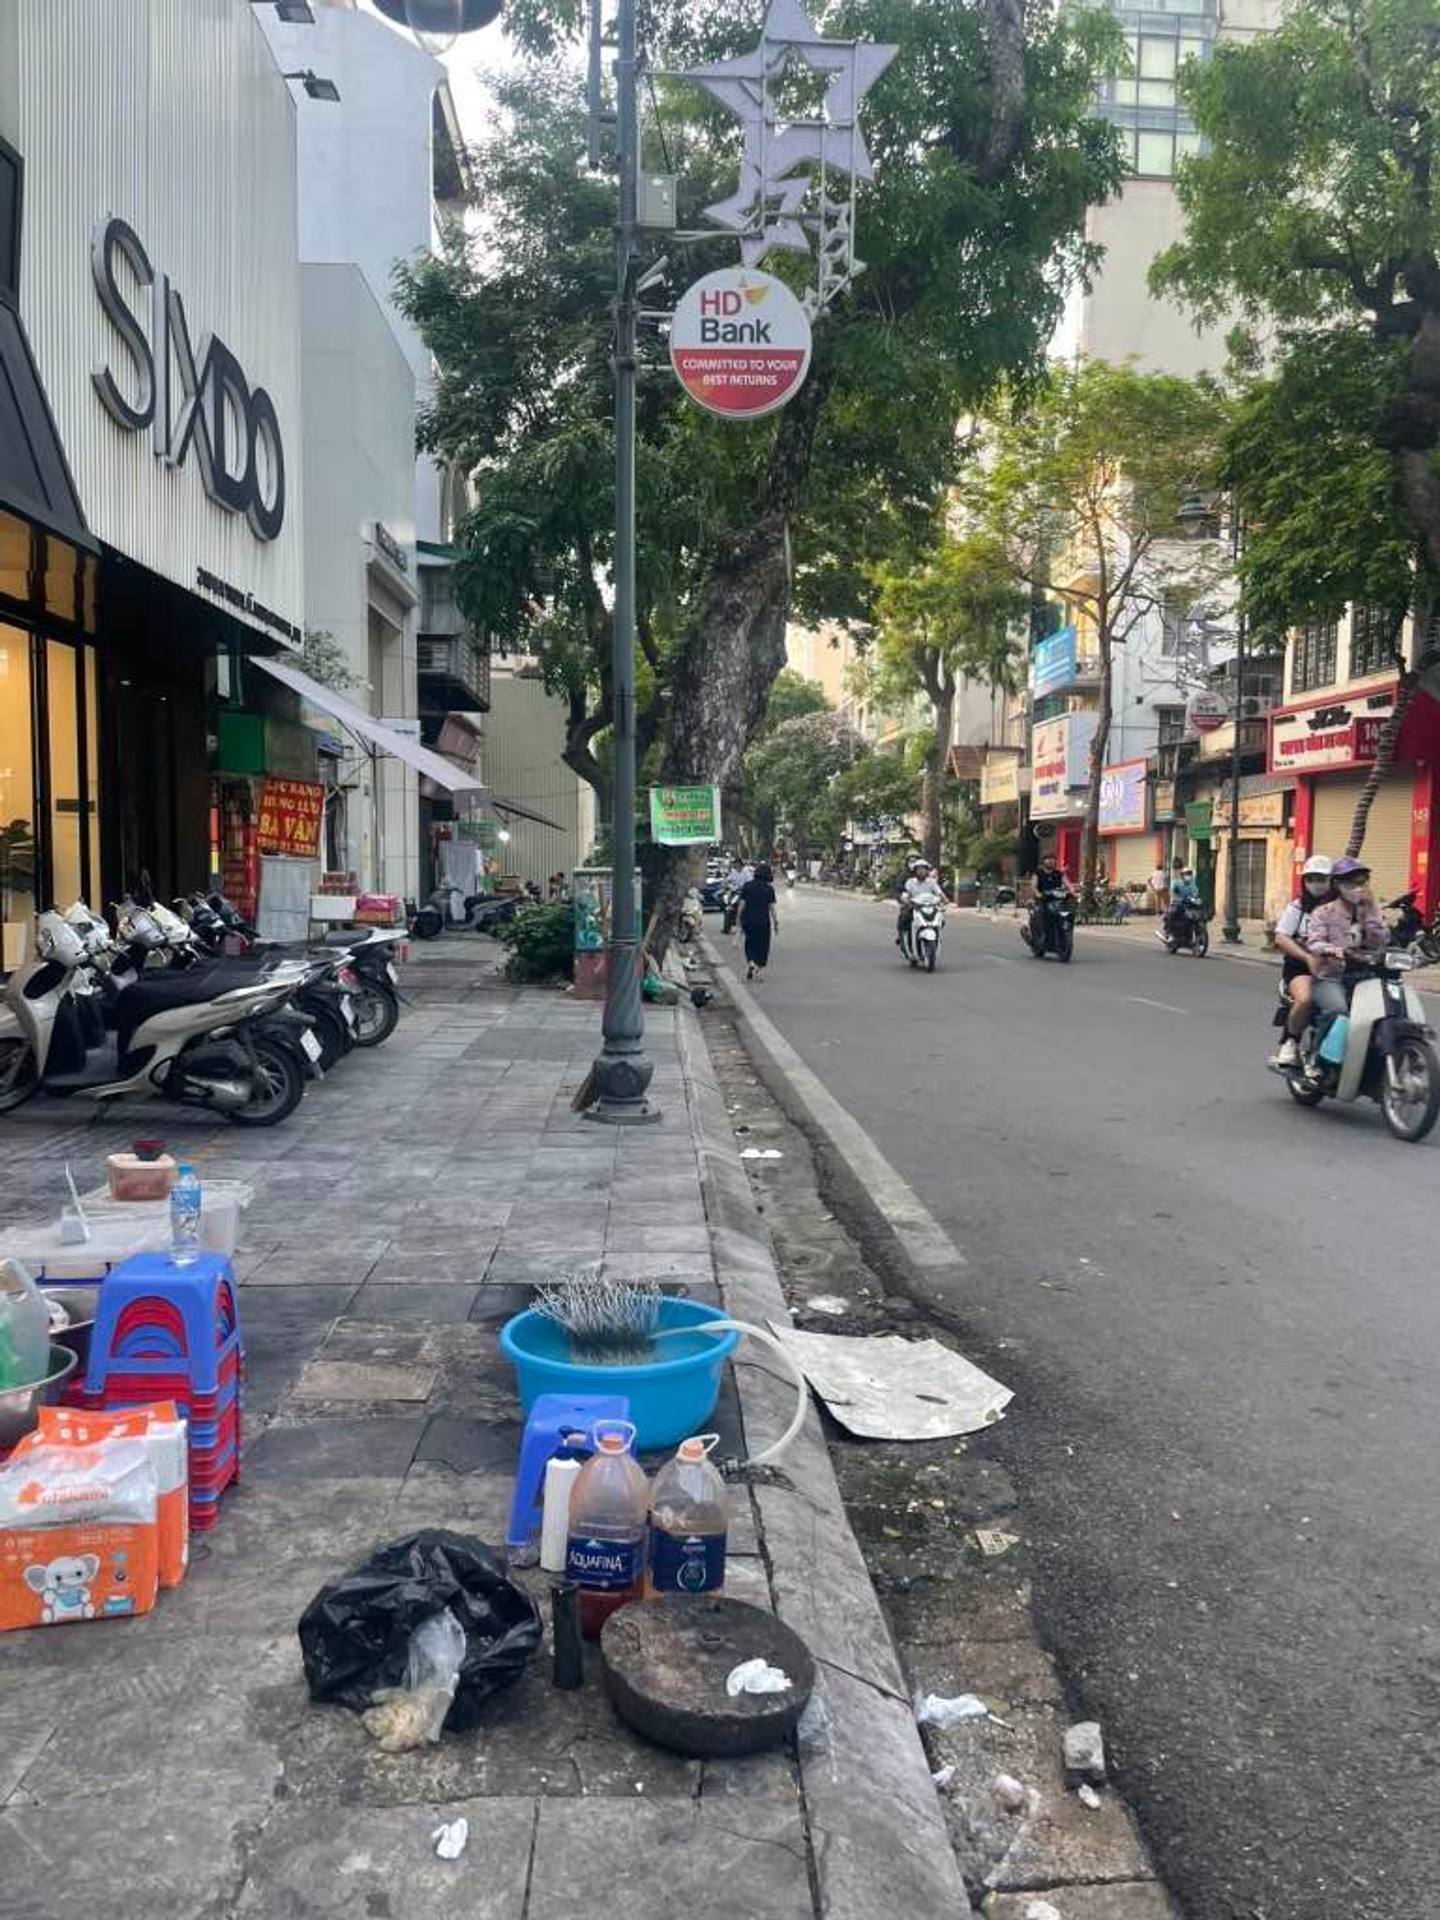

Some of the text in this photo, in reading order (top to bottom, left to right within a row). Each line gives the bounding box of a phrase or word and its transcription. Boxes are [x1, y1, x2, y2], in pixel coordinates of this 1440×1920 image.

[701, 290, 742, 316] HD
[701, 319, 771, 344] Bank
[683, 360, 798, 371] COMMITTED TO YOUR
[91, 217, 285, 542] SIXDO
[703, 374, 778, 386] BEST RETURNS
[569, 1550, 623, 1572] AQUAFINA
